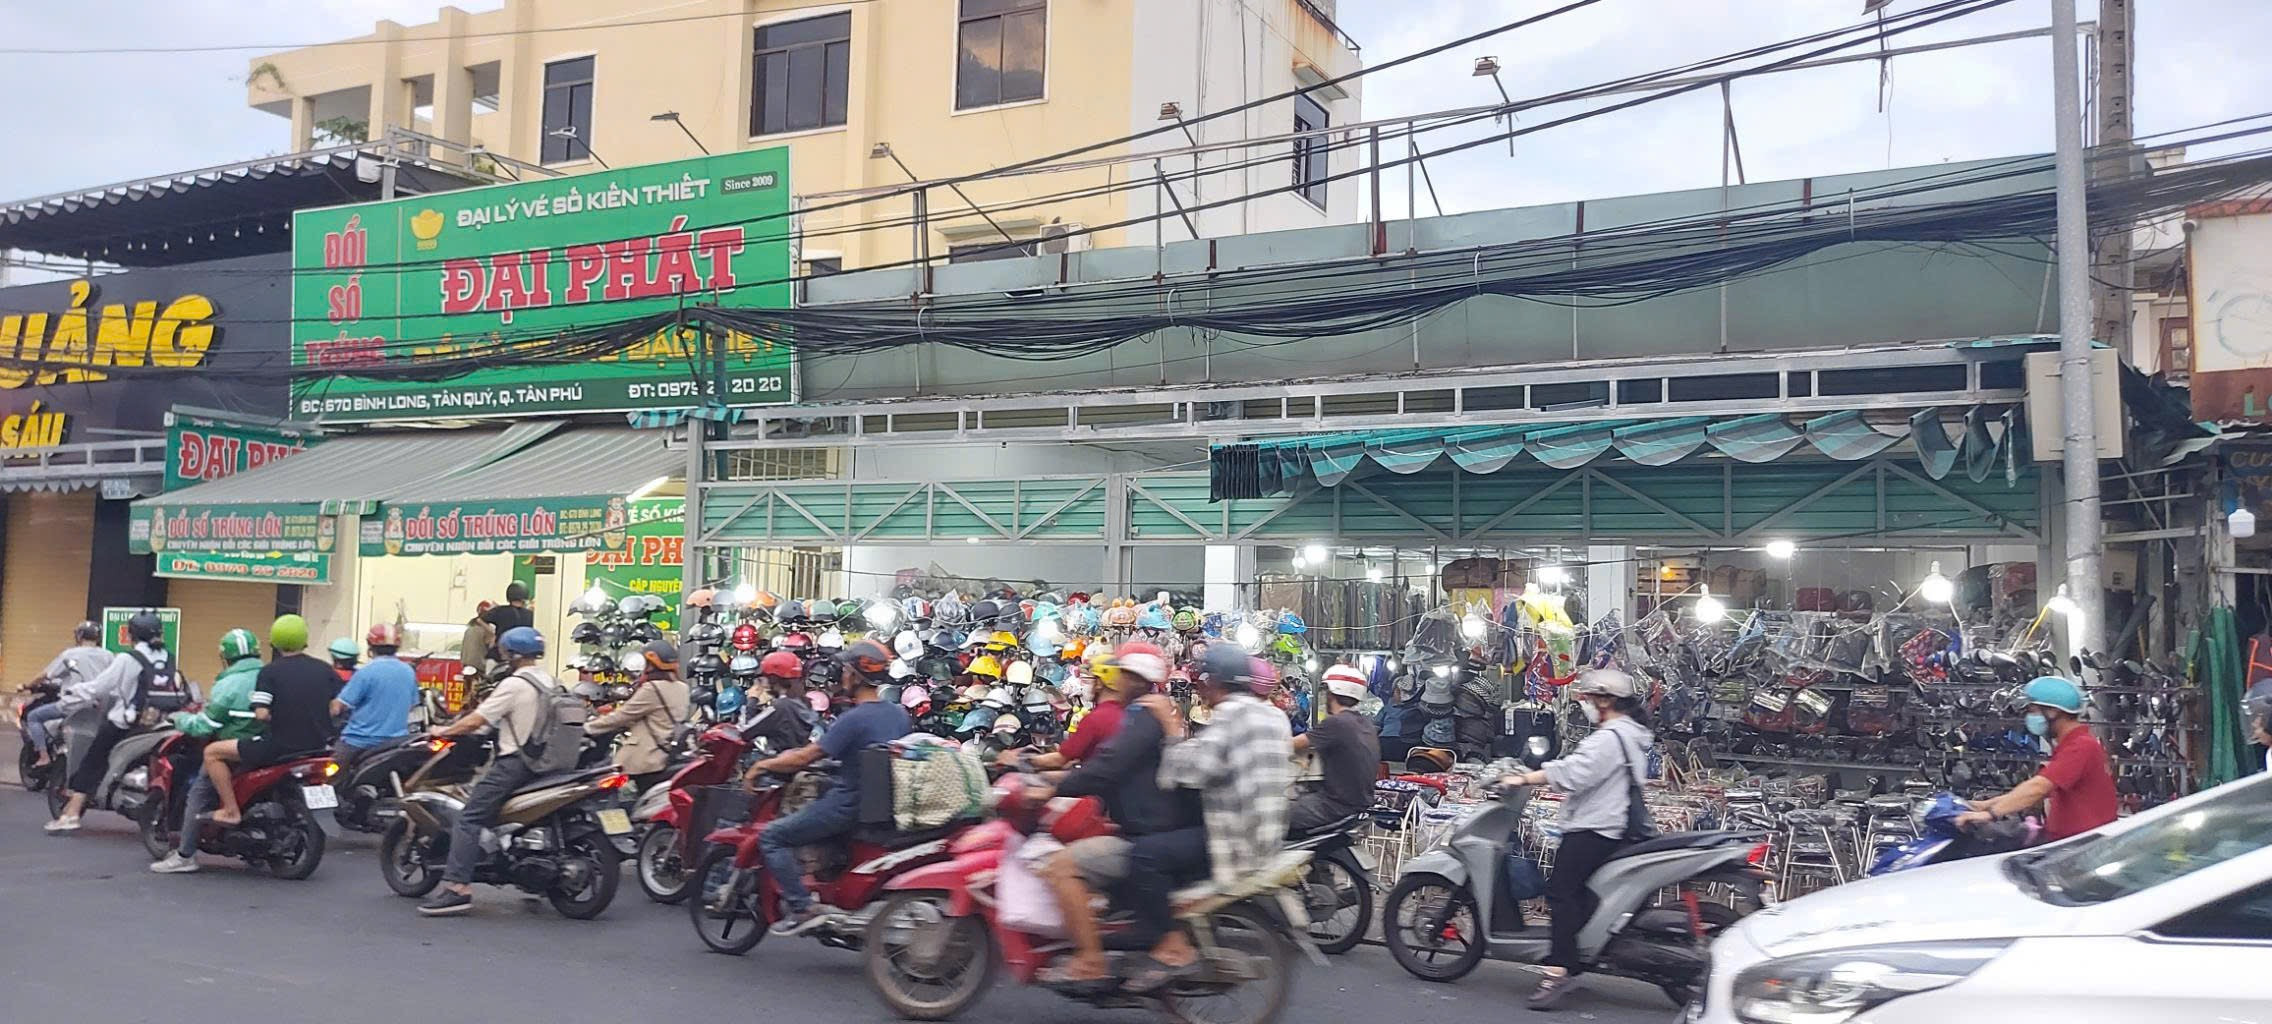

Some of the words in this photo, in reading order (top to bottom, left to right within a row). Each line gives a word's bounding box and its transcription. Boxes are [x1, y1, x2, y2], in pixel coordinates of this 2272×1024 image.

[457, 207, 491, 231] ĐẠI
[494, 198, 518, 221] LÝ
[521, 194, 549, 218] VÉ
[552, 186, 582, 214] SỐ
[587, 180, 639, 210] KIẾN
[642, 173, 711, 205] THIẾT
[724, 179, 751, 191] Since
[752, 175, 774, 187] 2009
[324, 213, 368, 270] ĐỔI
[440, 250, 551, 324] ĐẠI
[565, 215, 745, 304] PHÁT
[328, 269, 362, 325] SỐ
[325, 398, 351, 412] 670
[354, 393, 386, 411] BÌNH
[388, 394, 431, 411] LONG,
[432, 391, 463, 407] TÂN
[464, 388, 497, 409] QUÝ,
[499, 390, 514, 406] Q.
[515, 388, 548, 403] TÂN
[549, 382, 583, 401] PHÚ
[1, 399, 66, 459] SÁU
[212, 511, 254, 538] TRÚNG
[405, 505, 434, 541] ĐỔI
[436, 507, 462, 538] SỐ
[462, 508, 517, 538] TRÚNG
[641, 503, 662, 522] SỐ
